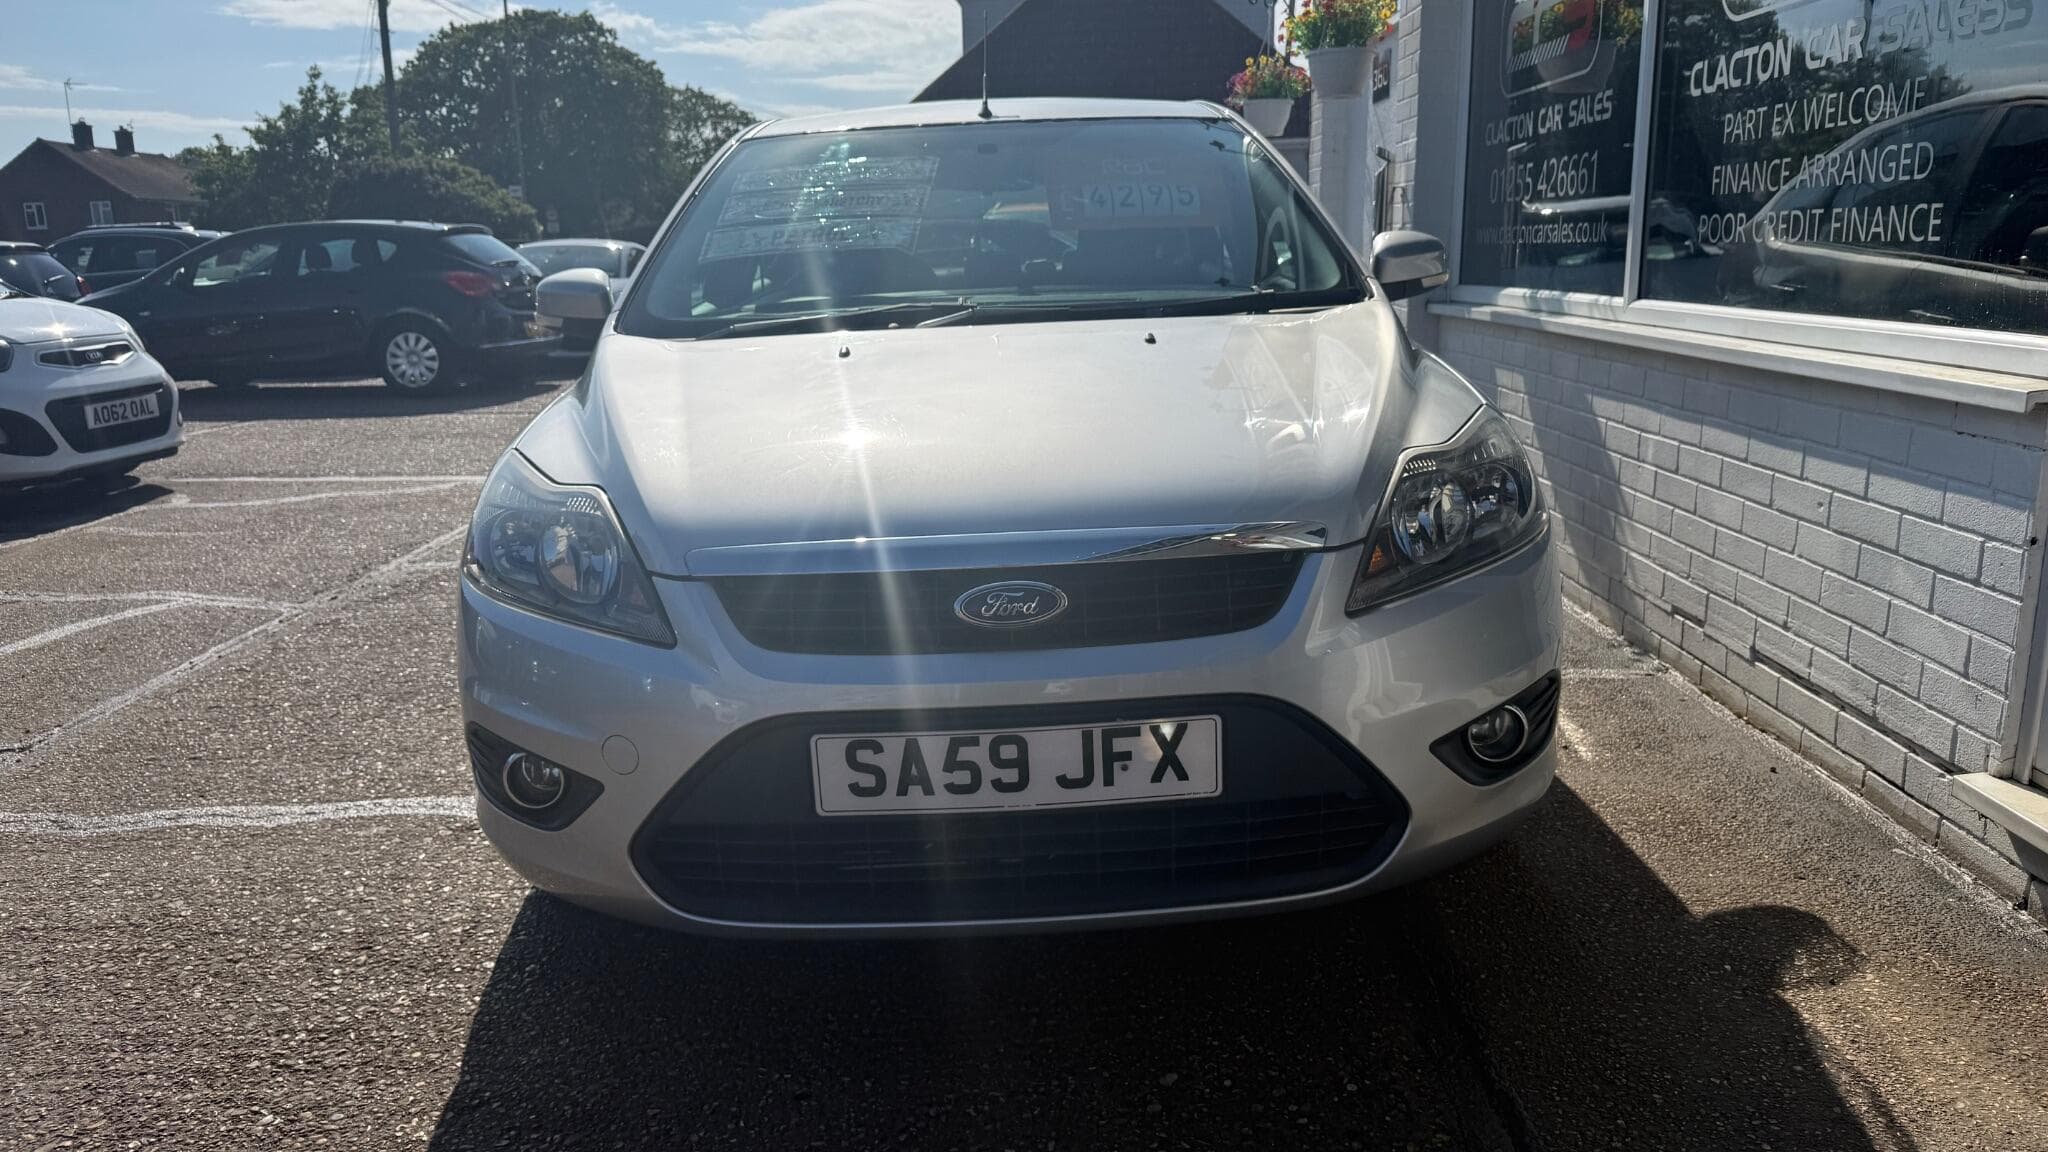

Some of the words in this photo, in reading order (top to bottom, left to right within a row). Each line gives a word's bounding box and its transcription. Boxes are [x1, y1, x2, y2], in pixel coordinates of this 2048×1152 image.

[1690, 38, 1793, 97] CLACTON
[1805, 17, 1868, 71] CAR
[1876, 0, 2010, 53] SALES
[1485, 110, 1534, 147] CLACTON
[1538, 103, 1563, 135] CAR
[1568, 88, 1614, 128] SALES
[1723, 106, 1768, 145] PART
[1772, 101, 1799, 137] EX
[1803, 76, 1928, 132] WELCOME
[1537, 151, 1599, 199] 426661
[1712, 157, 1792, 196] FINANCE
[1796, 141, 1935, 190] ARRANGED
[1090, 184, 1195, 208] 4295
[1698, 212, 1747, 244] POOR
[1752, 209, 1825, 243] CREDIT
[1830, 203, 1945, 243] FINANCE
[93, 402, 129, 425] AO62
[130, 398, 154, 418] OAL
[981, 591, 1040, 618] Ford
[845, 733, 1030, 798] SA59
[1055, 722, 1190, 790] JFX
